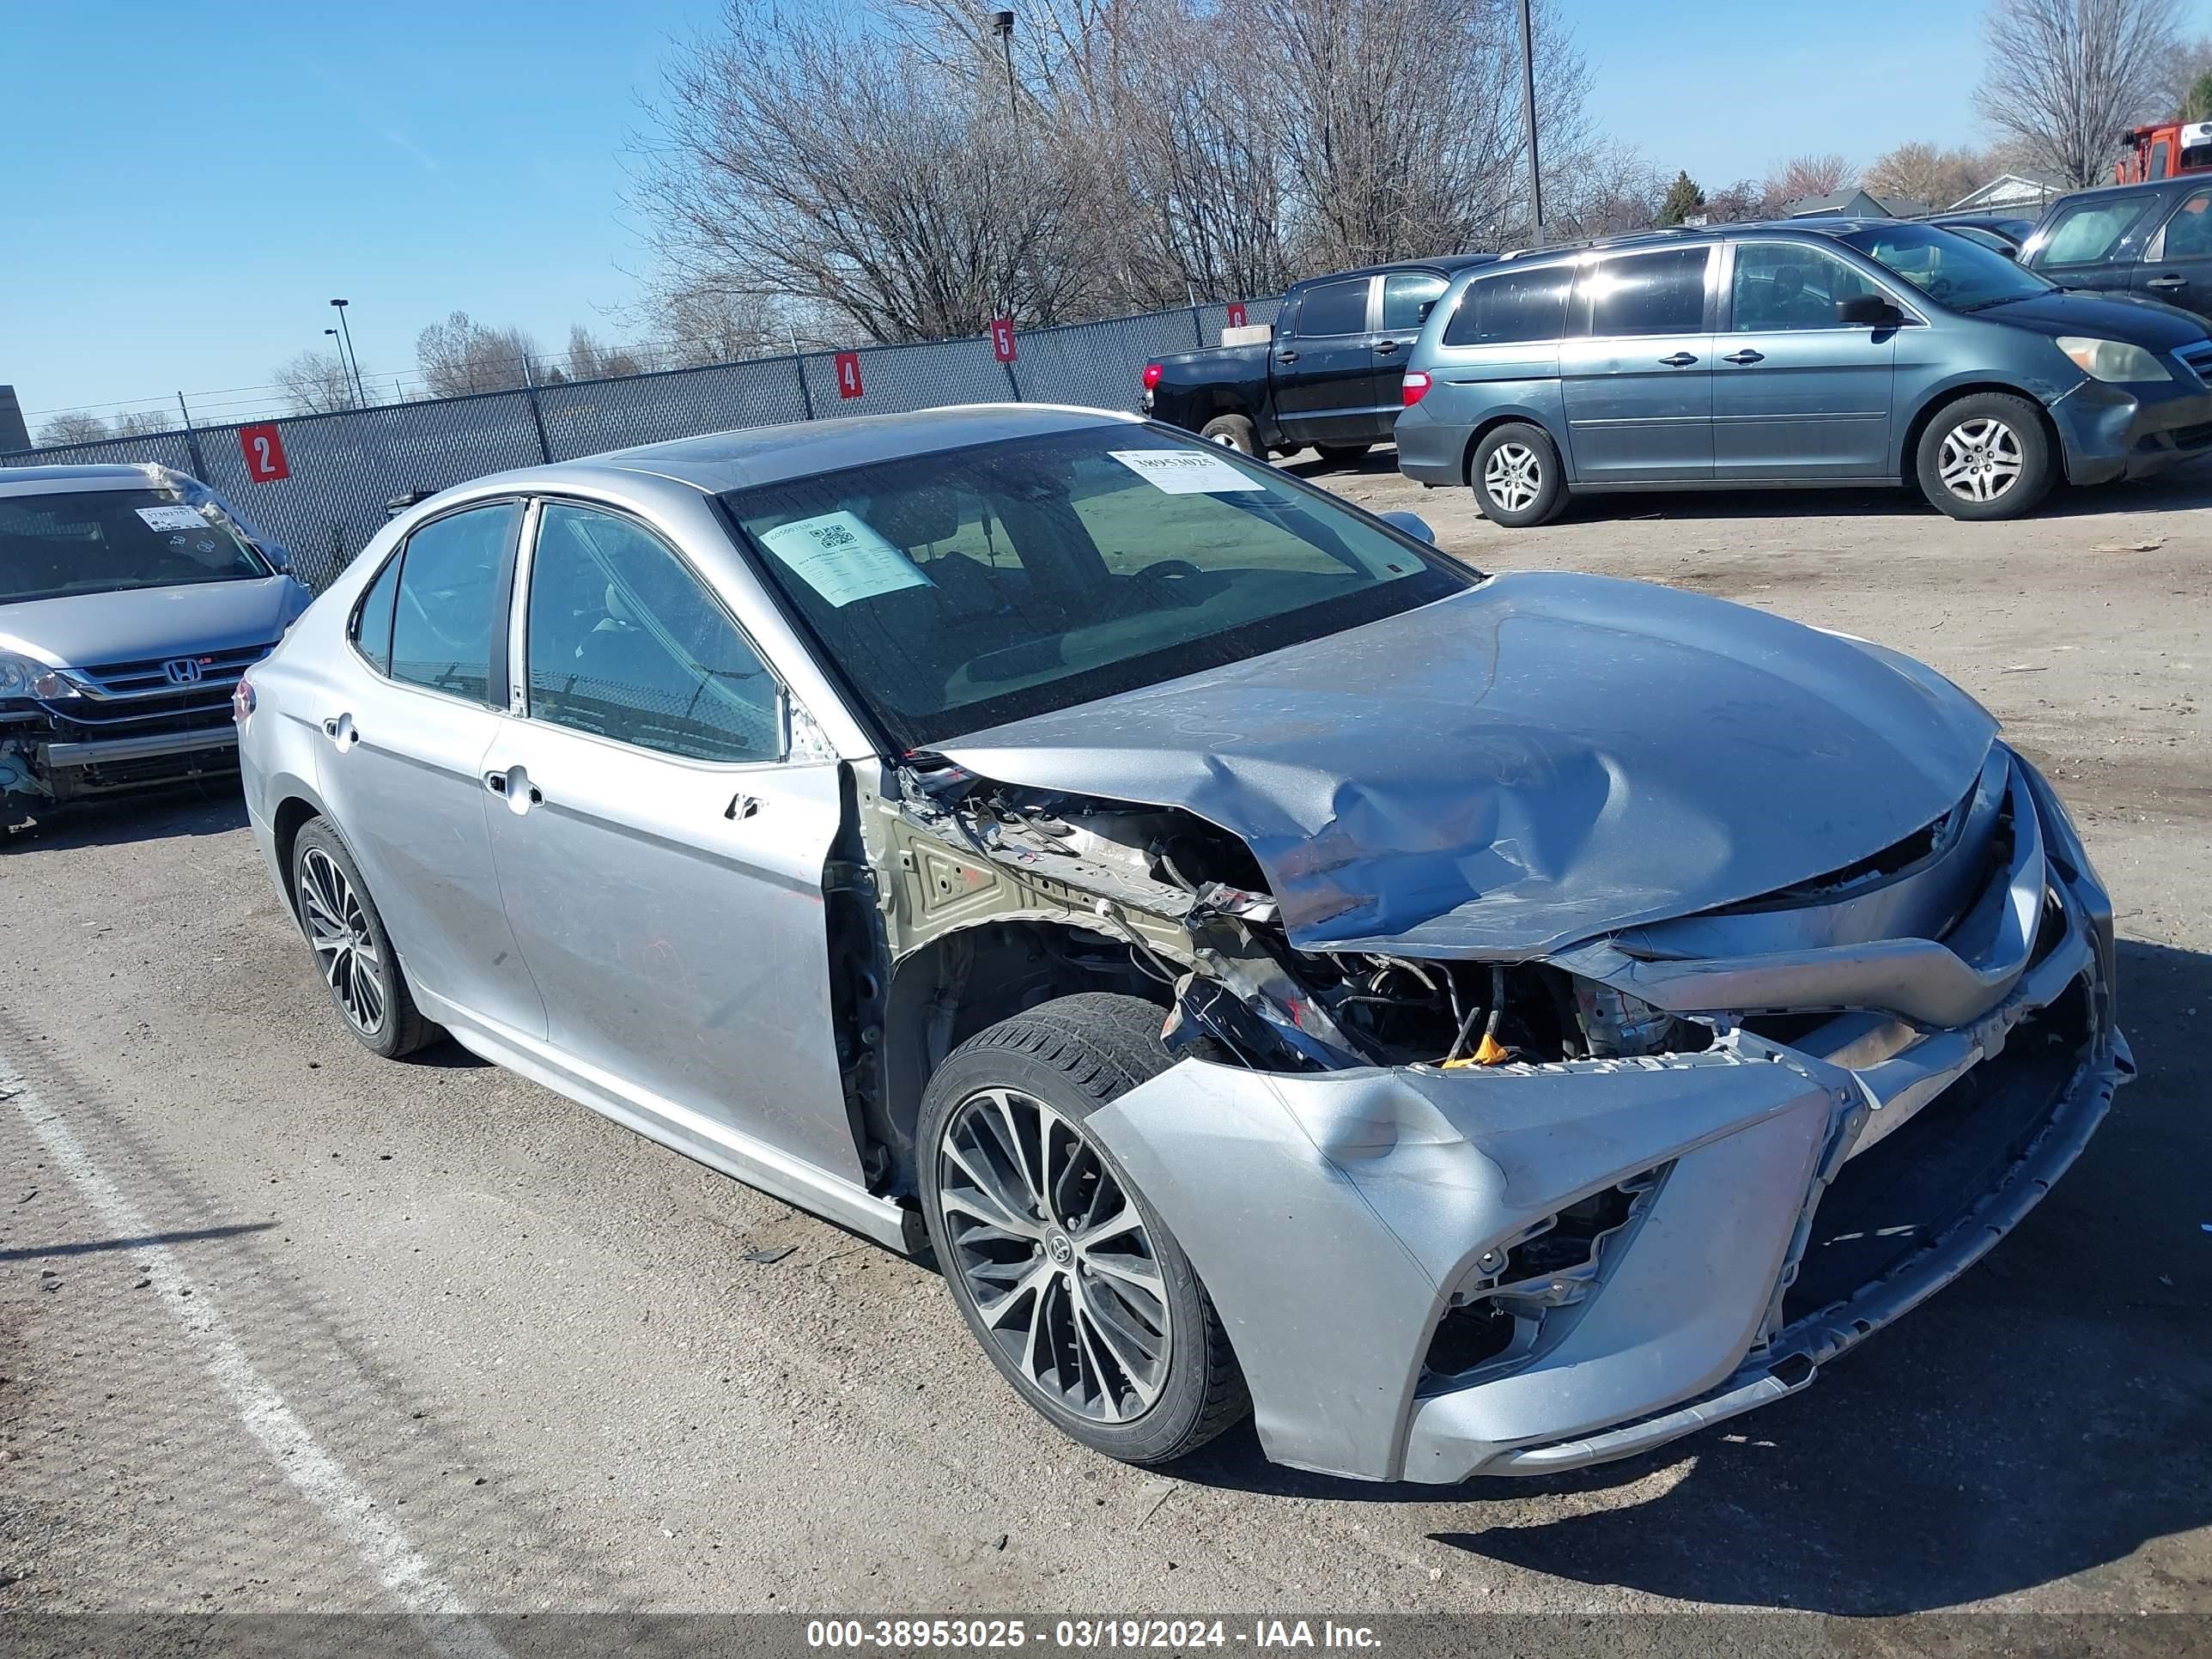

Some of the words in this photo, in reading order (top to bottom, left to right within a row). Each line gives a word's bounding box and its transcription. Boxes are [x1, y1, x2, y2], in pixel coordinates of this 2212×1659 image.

[998, 329, 1009, 356] 5
[845, 362, 855, 390] 4
[253, 436, 276, 473] 2
[1133, 458, 1217, 469] 38953025
